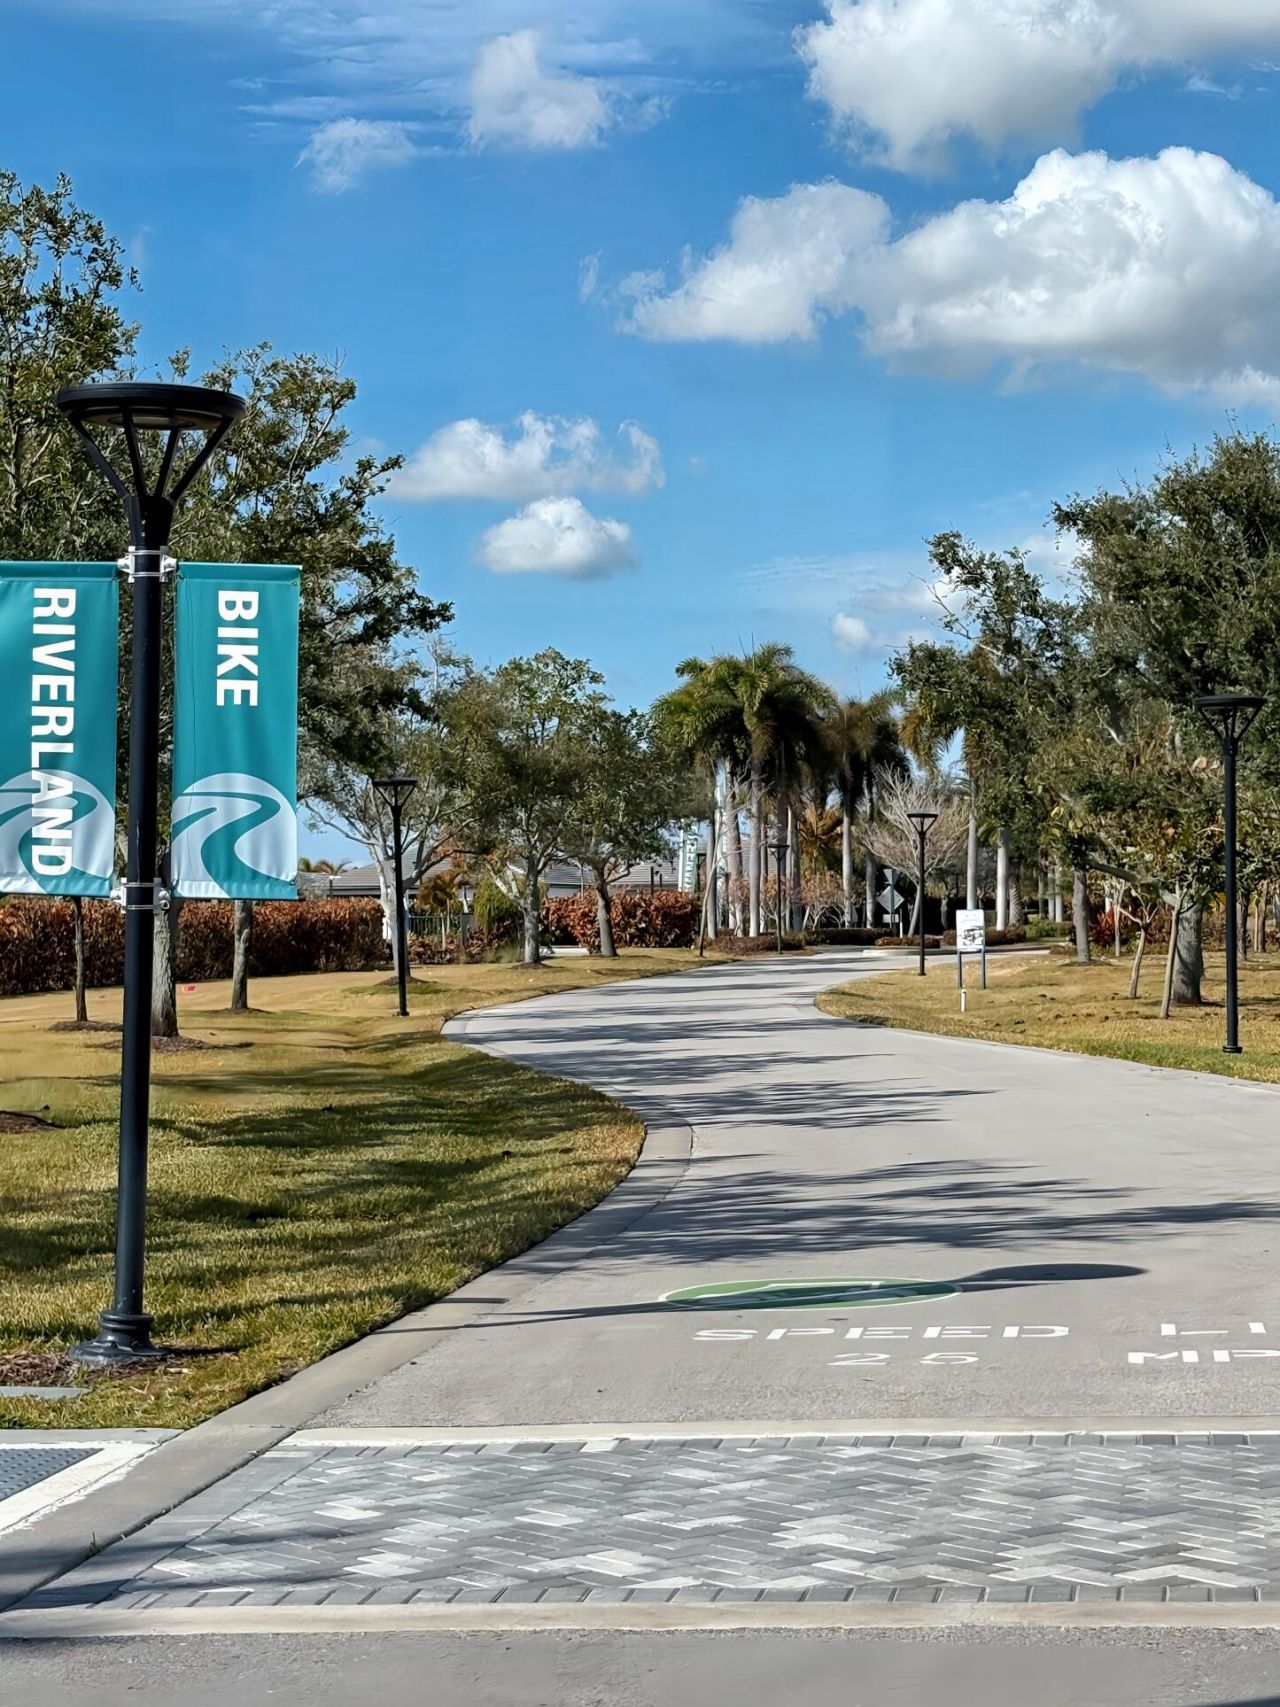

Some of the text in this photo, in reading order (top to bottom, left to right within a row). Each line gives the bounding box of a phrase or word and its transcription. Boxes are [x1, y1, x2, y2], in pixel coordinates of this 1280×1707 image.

[216, 590, 259, 707] BIKE
[31, 588, 76, 876] RIVERLAND
[692, 1325, 1070, 1341] SPEED
[826, 1351, 980, 1366] 25
